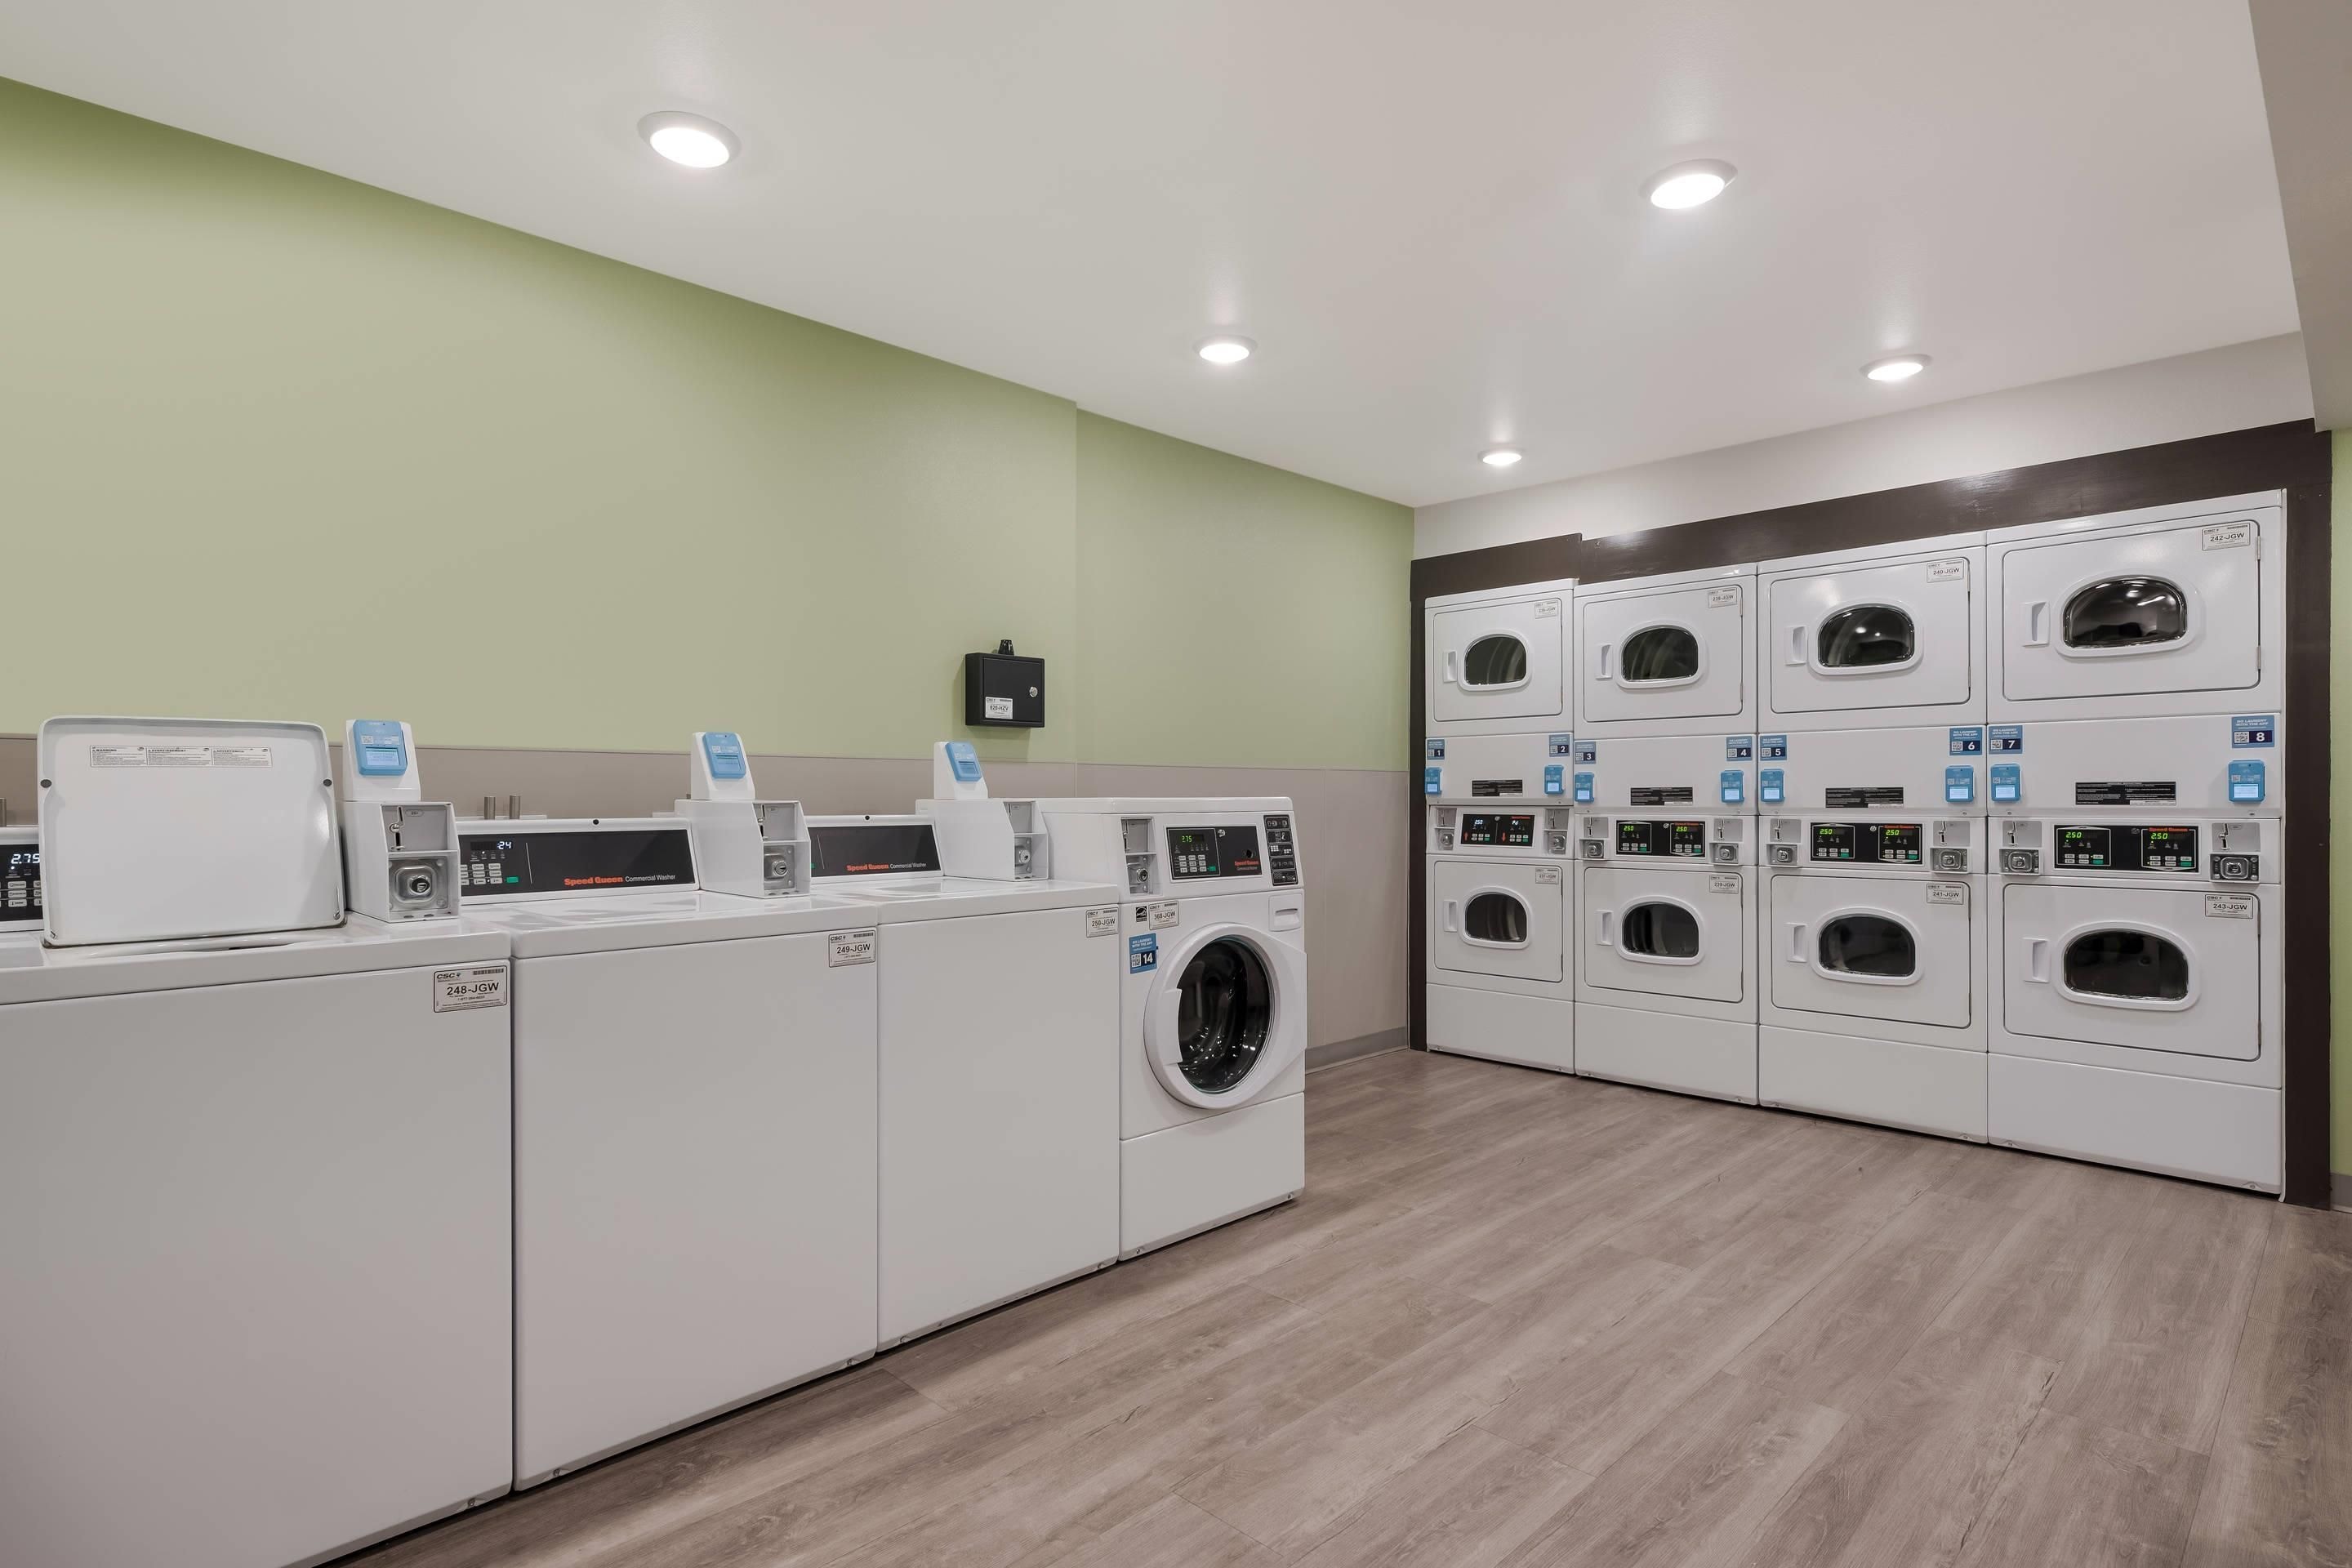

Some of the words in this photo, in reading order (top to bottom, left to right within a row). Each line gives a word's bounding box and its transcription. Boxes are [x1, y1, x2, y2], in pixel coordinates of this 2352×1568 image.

[2211, 532, 2244, 541] 242-JGW
[2256, 732, 2265, 742] 8
[1968, 742, 1975, 750] 6
[2008, 740, 2016, 748] 7
[564, 877, 594, 886] Speed
[1092, 918, 1115, 927] 250-JGW
[837, 943, 870, 954] 249-JGW
[1143, 953, 1153, 964] 14
[447, 982, 499, 995] 248-JGW
